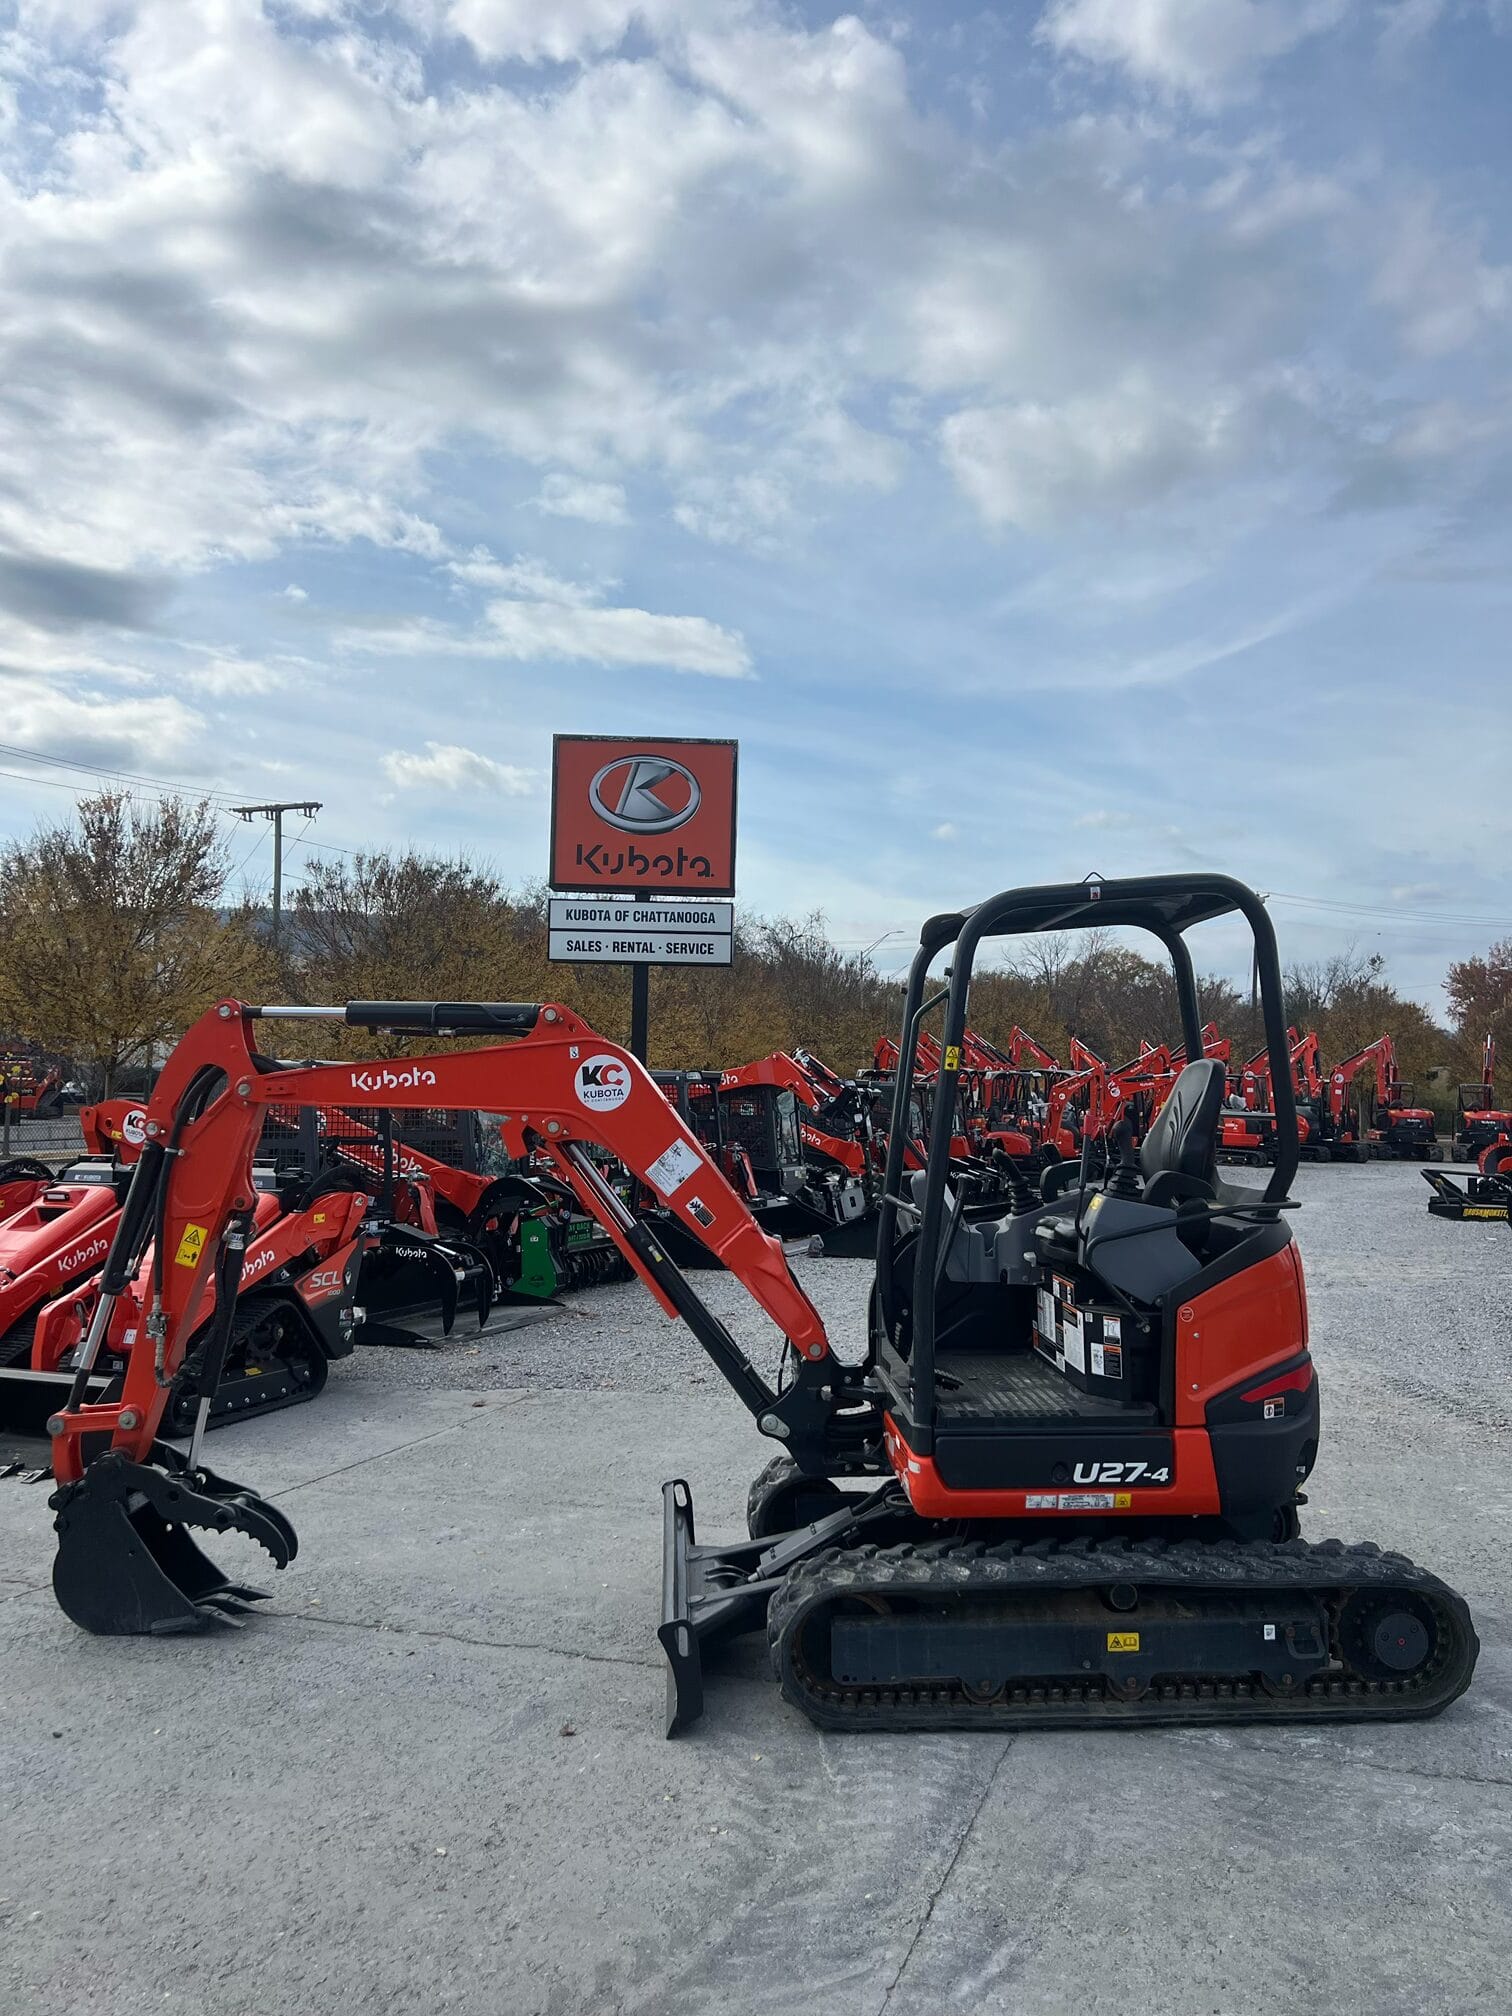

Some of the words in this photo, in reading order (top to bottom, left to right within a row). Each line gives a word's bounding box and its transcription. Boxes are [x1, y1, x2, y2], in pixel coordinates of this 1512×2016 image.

[576, 843, 711, 877] Kubota
[565, 908, 612, 923] KUBOTA
[614, 909, 630, 923] OF
[632, 909, 716, 925] CHATTANOOGA
[566, 939, 602, 953] SALES
[612, 941, 656, 955] RENTAL
[665, 942, 715, 955] SERVICE
[351, 1066, 436, 1092] Kubota
[581, 1063, 624, 1087] KC
[583, 1088, 624, 1099] KUBOTA
[58, 1239, 109, 1272] Kubota
[395, 1246, 428, 1259] Kubota
[310, 1271, 341, 1288] SCL
[1072, 1461, 1169, 1484] U27-4
